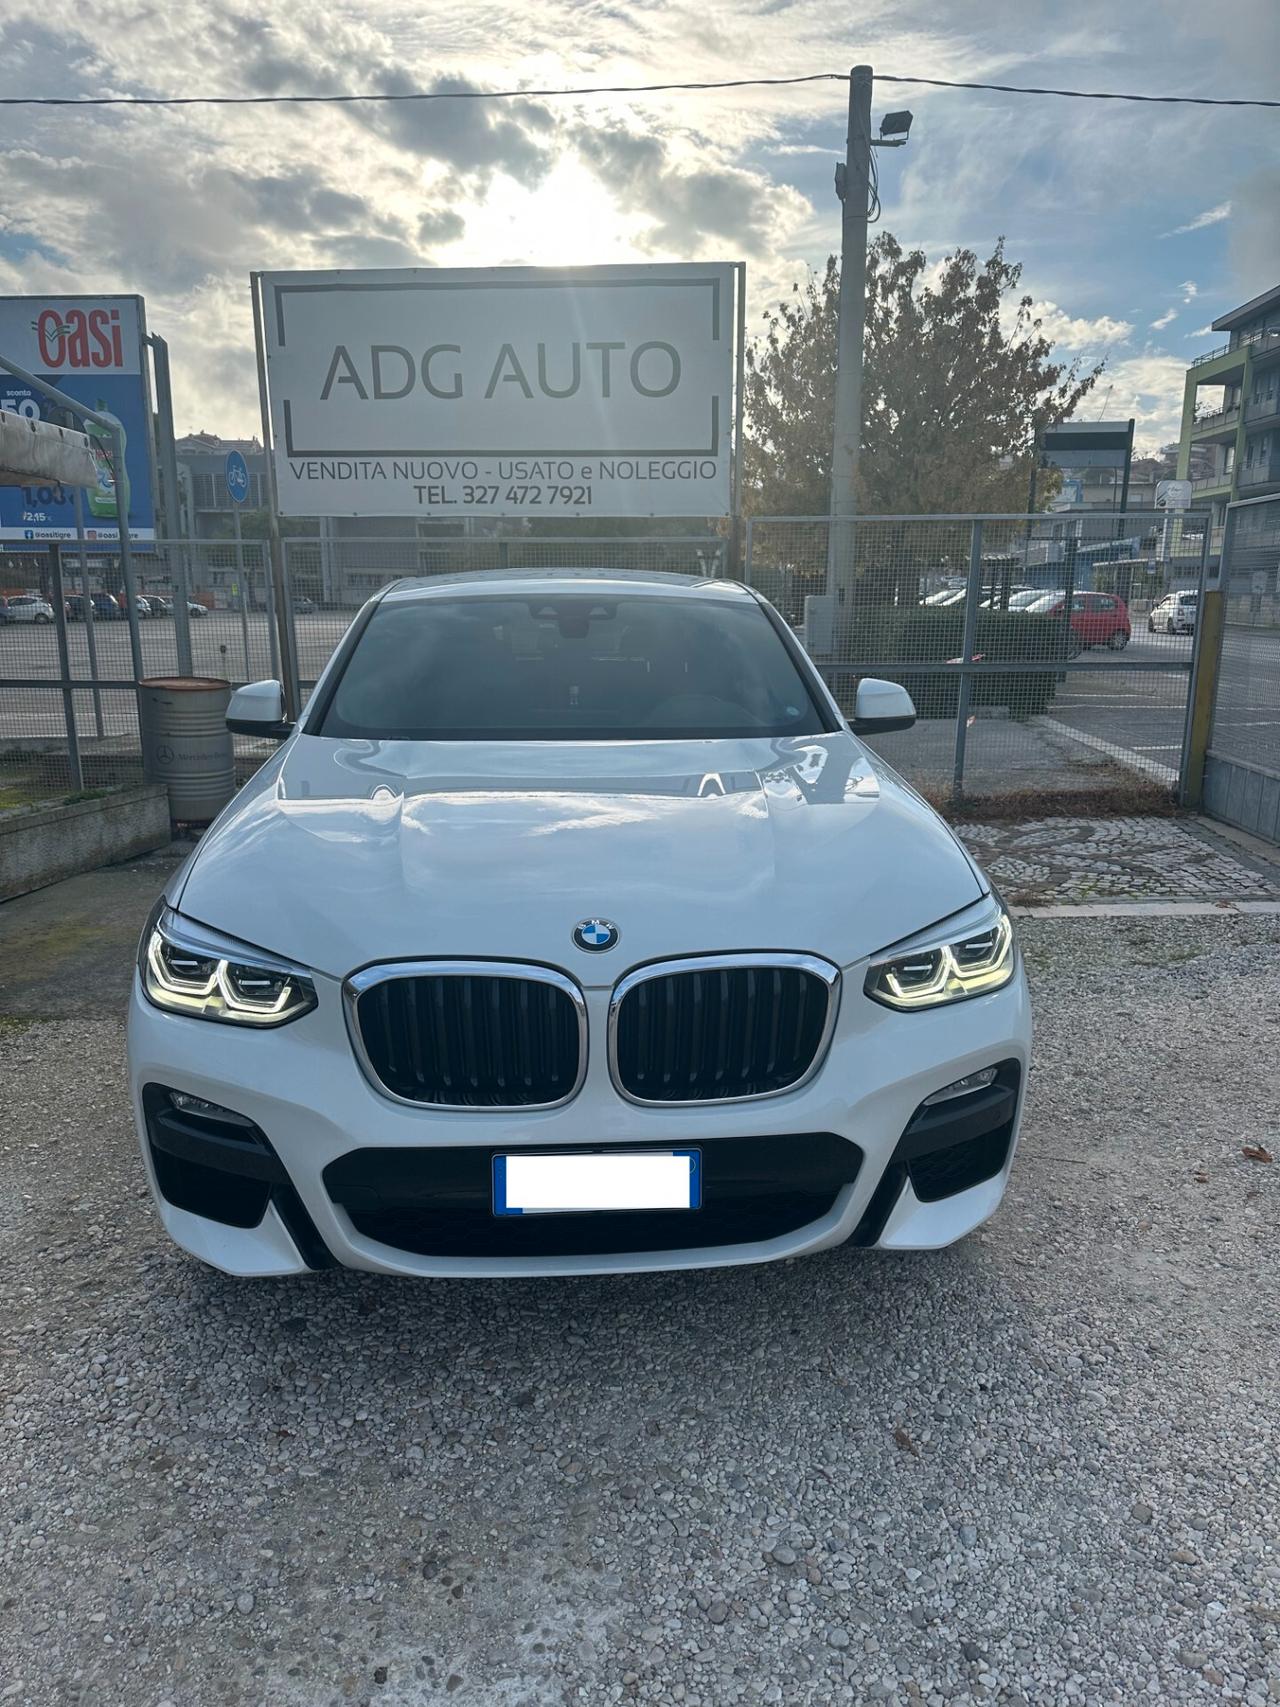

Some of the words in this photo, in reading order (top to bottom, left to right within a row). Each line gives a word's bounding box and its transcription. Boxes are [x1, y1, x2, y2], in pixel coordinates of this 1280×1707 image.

[37, 309, 123, 368] Oasi
[319, 343, 464, 401] ADG
[484, 340, 682, 400] AUTO
[289, 461, 387, 481] VENDITA
[393, 461, 478, 480] NUOVO
[498, 461, 574, 480] USATO
[580, 466, 593, 480] e
[599, 460, 717, 480] NOLEGGIO
[413, 485, 457, 505] TEL.
[462, 485, 500, 505] 327
[505, 485, 543, 505] 472
[547, 485, 592, 505] 7921
